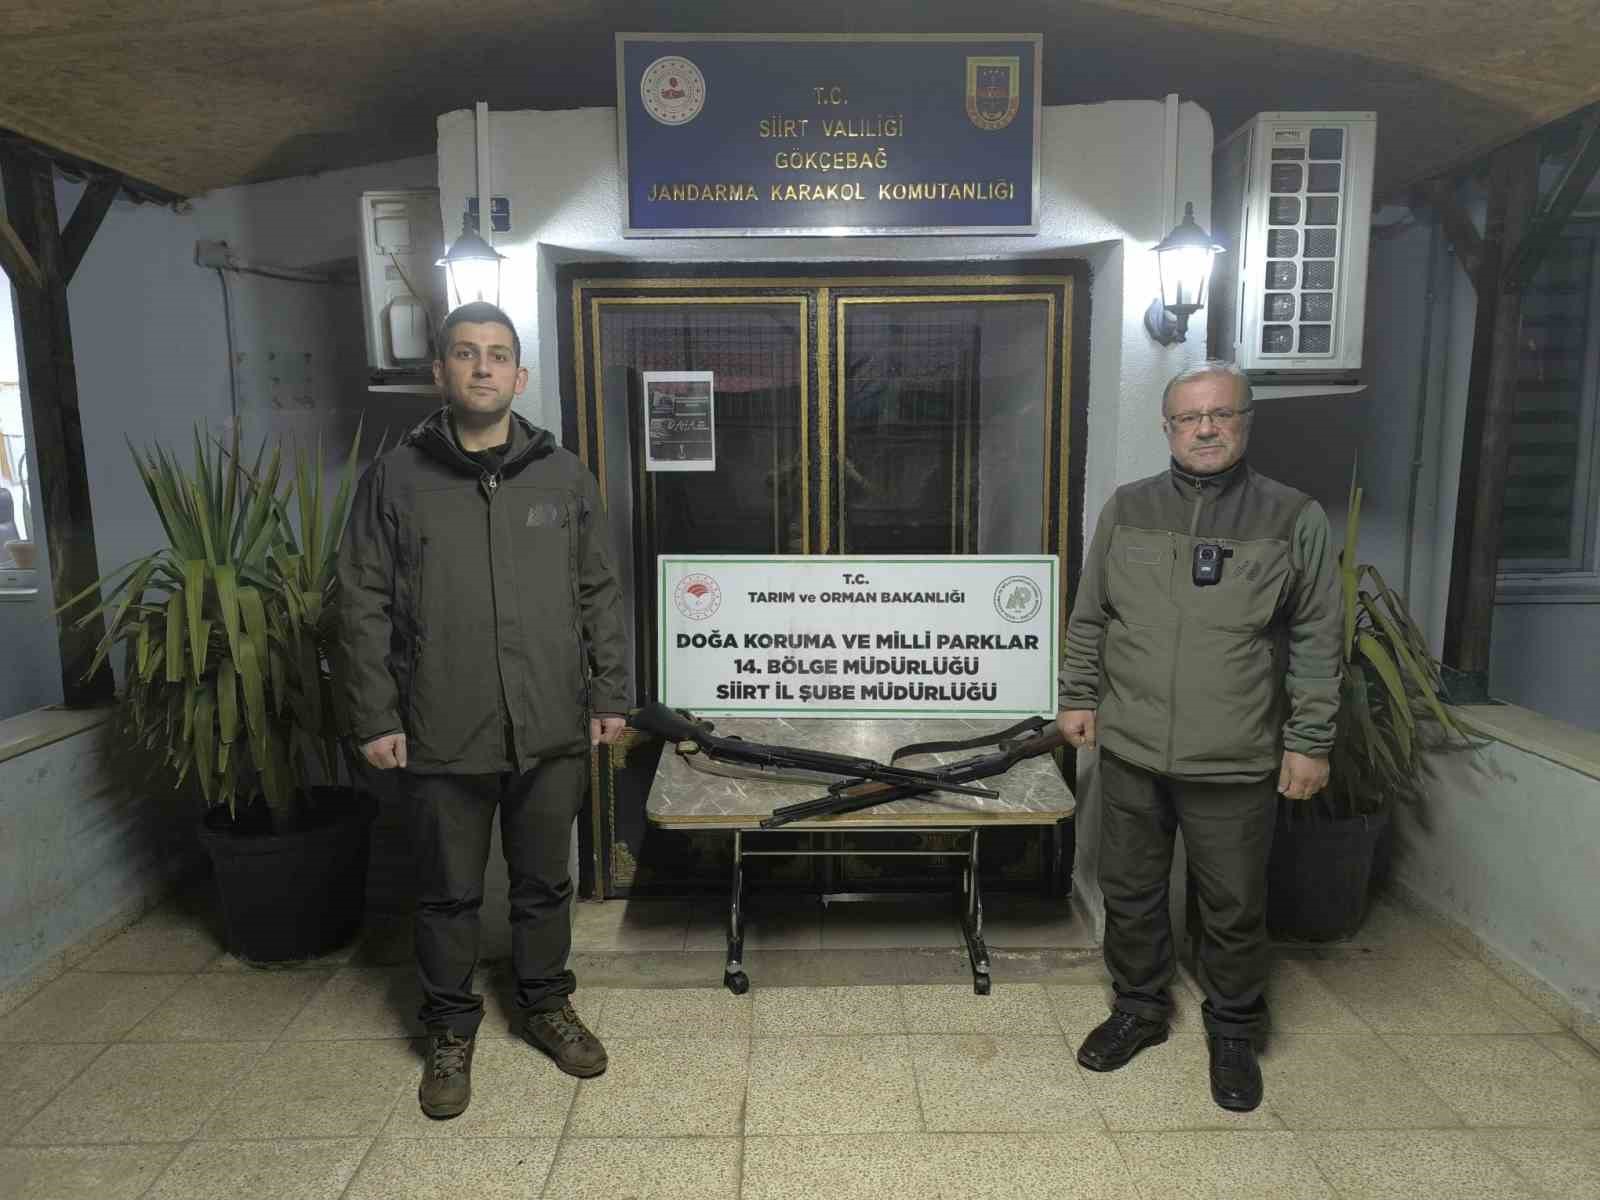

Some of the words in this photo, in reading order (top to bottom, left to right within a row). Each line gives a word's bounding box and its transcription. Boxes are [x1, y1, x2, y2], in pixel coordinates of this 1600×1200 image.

[814, 87, 848, 105] T.C.
[775, 147, 888, 172] GÖKÇEBAĞ
[648, 184, 759, 201] JANDARMA
[771, 183, 865, 200] KARAKOL
[879, 178, 1013, 200] KOMUTANLIĞI
[842, 573, 870, 585] T.C.
[748, 591, 795, 603] TARIM
[799, 593, 817, 603] ve
[819, 591, 877, 603] ORMAN
[880, 589, 965, 603] BAKANLIĞI
[677, 630, 739, 649] DOĞA
[744, 633, 837, 649] KORUMA
[842, 634, 871, 649] VE
[876, 631, 932, 649] MİLLİ
[936, 634, 1039, 650] PARKLAR
[734, 659, 762, 674] 14.
[767, 656, 838, 674] BÖLGE
[843, 656, 979, 675] MÜDÜRLÜĞÜ
[716, 681, 770, 700] SİİRT
[775, 681, 794, 700] İL
[799, 685, 856, 703] ŞUBE
[860, 682, 997, 701] MÜDÜRLÜĞÜ
